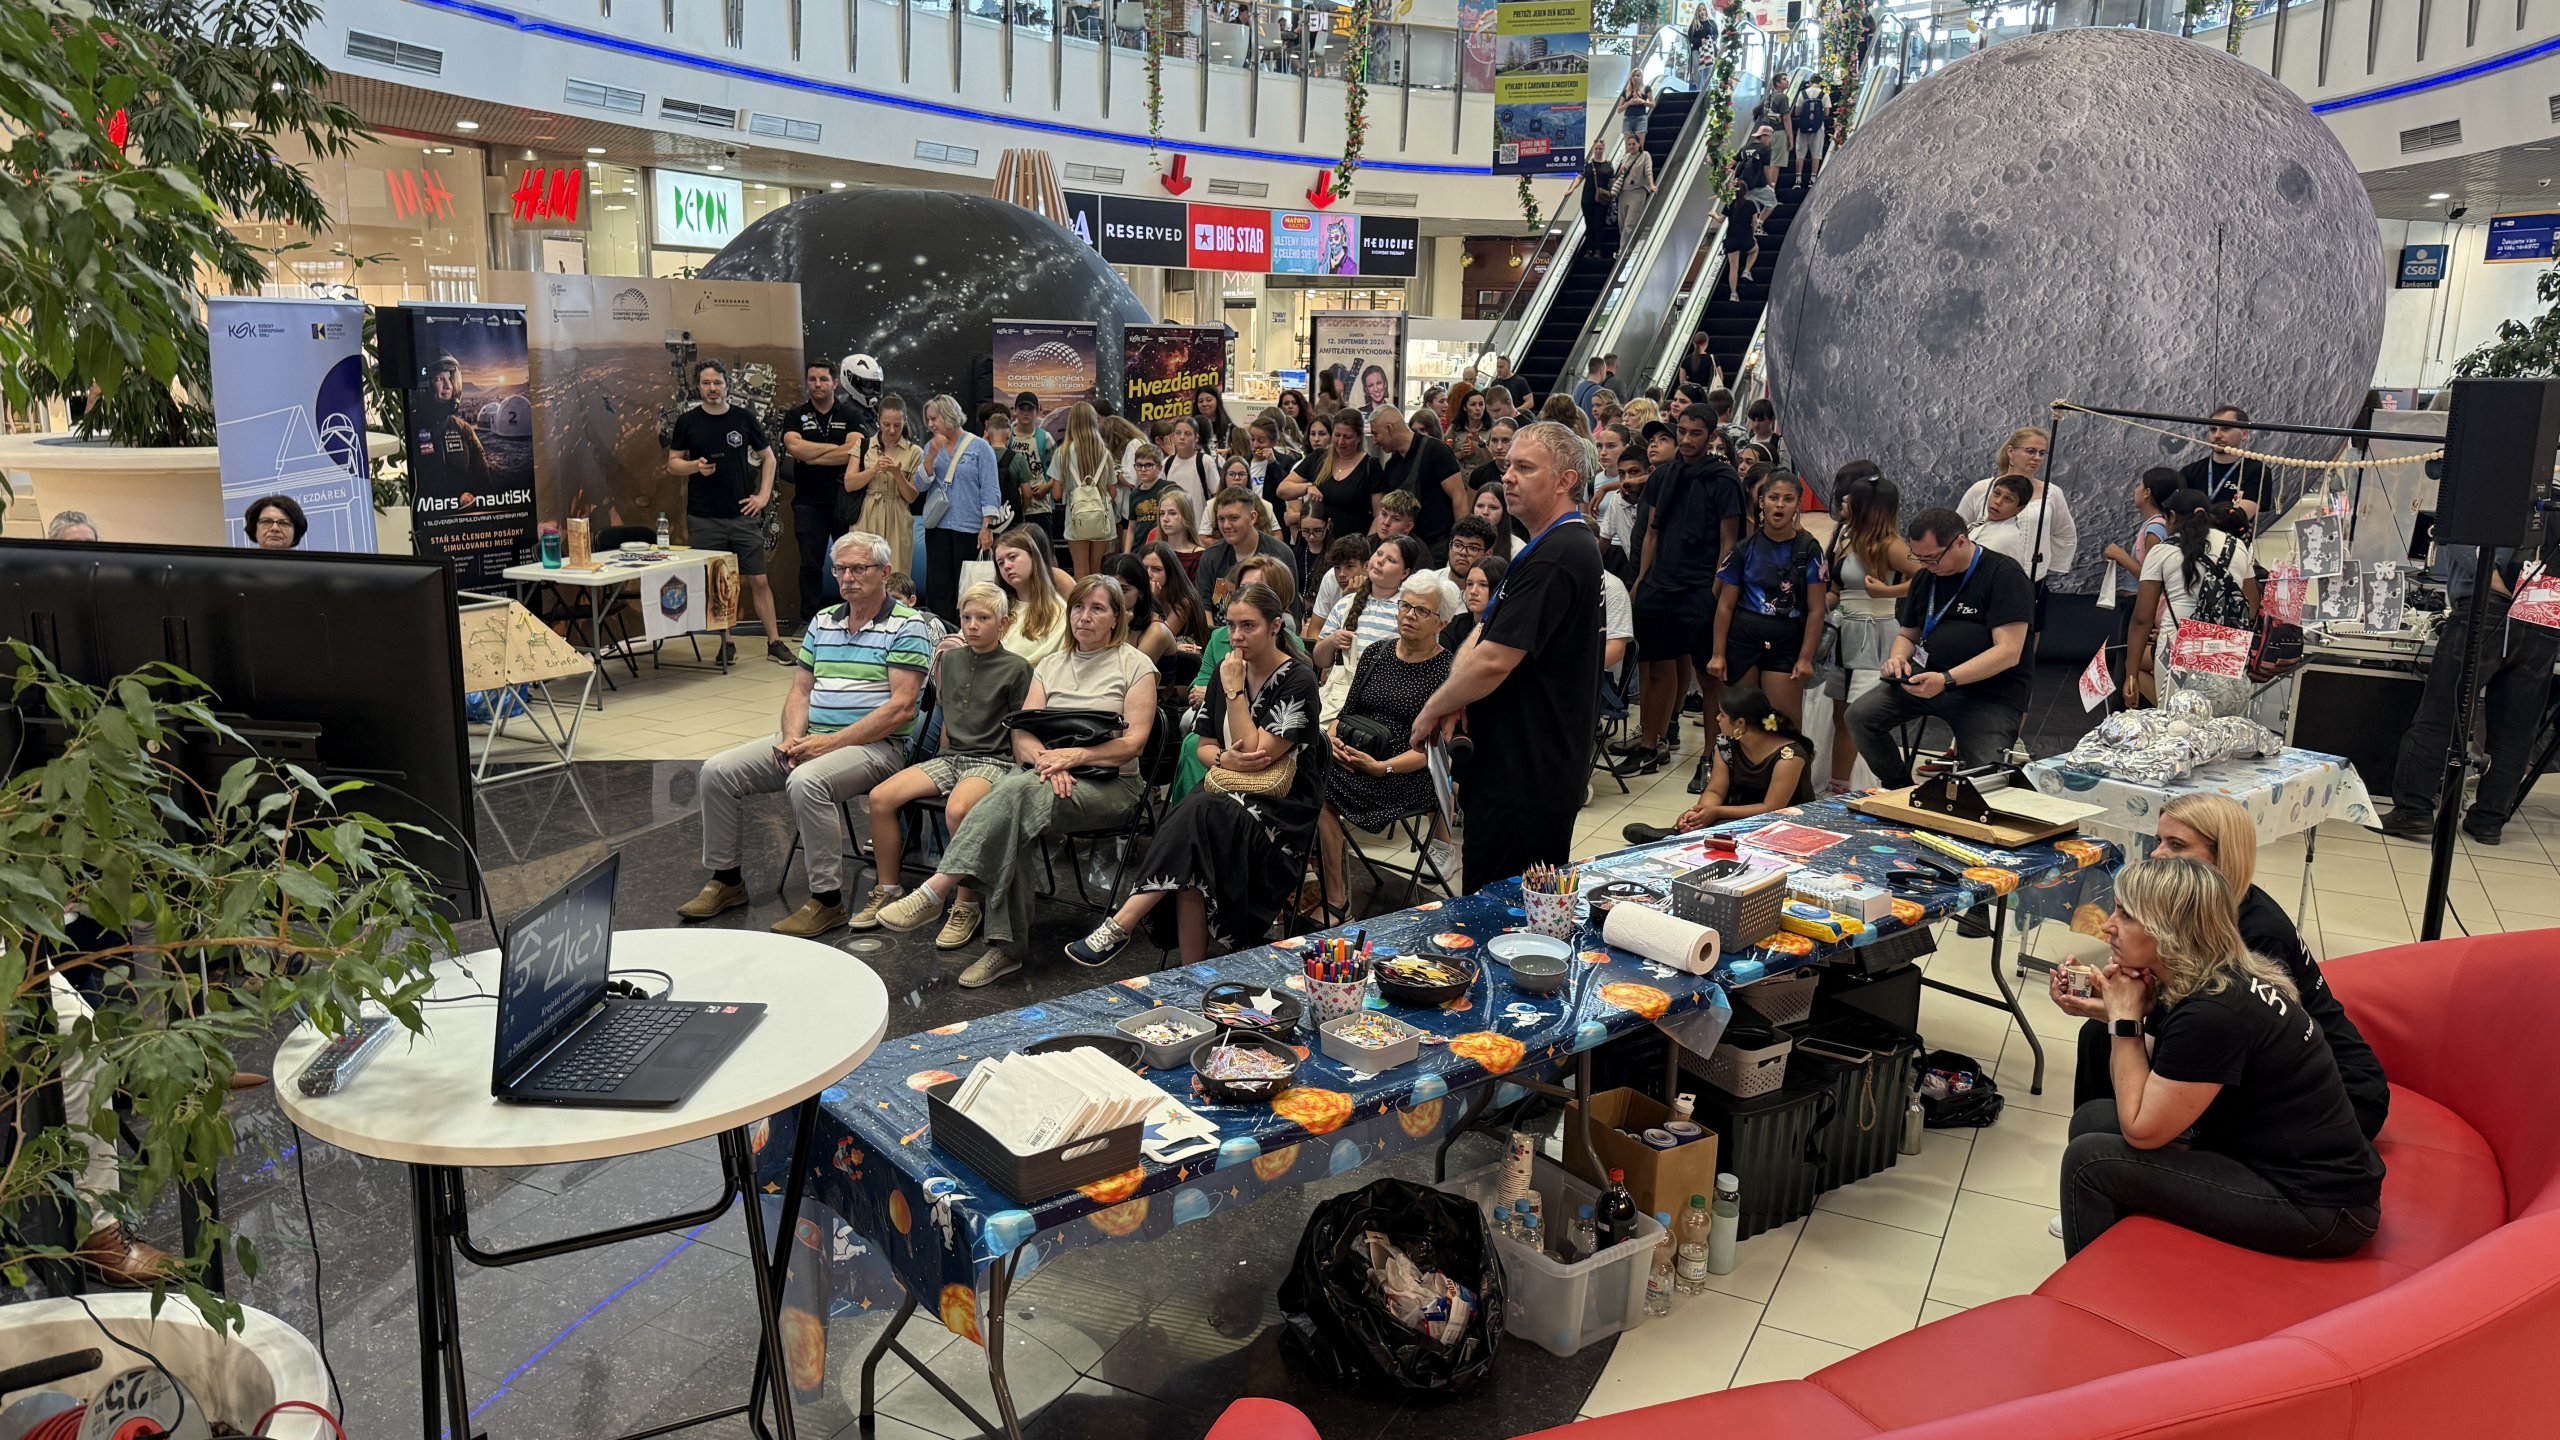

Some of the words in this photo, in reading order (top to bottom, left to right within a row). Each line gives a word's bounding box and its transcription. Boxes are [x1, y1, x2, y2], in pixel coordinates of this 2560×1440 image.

[512, 168, 581, 224] H&M
[1106, 223, 1182, 242] RESERVED
[1216, 225, 1234, 252] BIG
[1236, 226, 1264, 254] STAR
[1364, 237, 1414, 250] MEDICINE
[2404, 264, 2437, 276] ČSOB
[1128, 366, 1219, 399] Hvezdáreň
[508, 411, 518, 424] 2
[430, 534, 449, 544] STAŇ
[462, 532, 492, 541] ČLENOM
[494, 528, 524, 537] POSÁDKY
[443, 540, 492, 552] SIMULOVANEJ
[494, 538, 514, 546] MISIE
